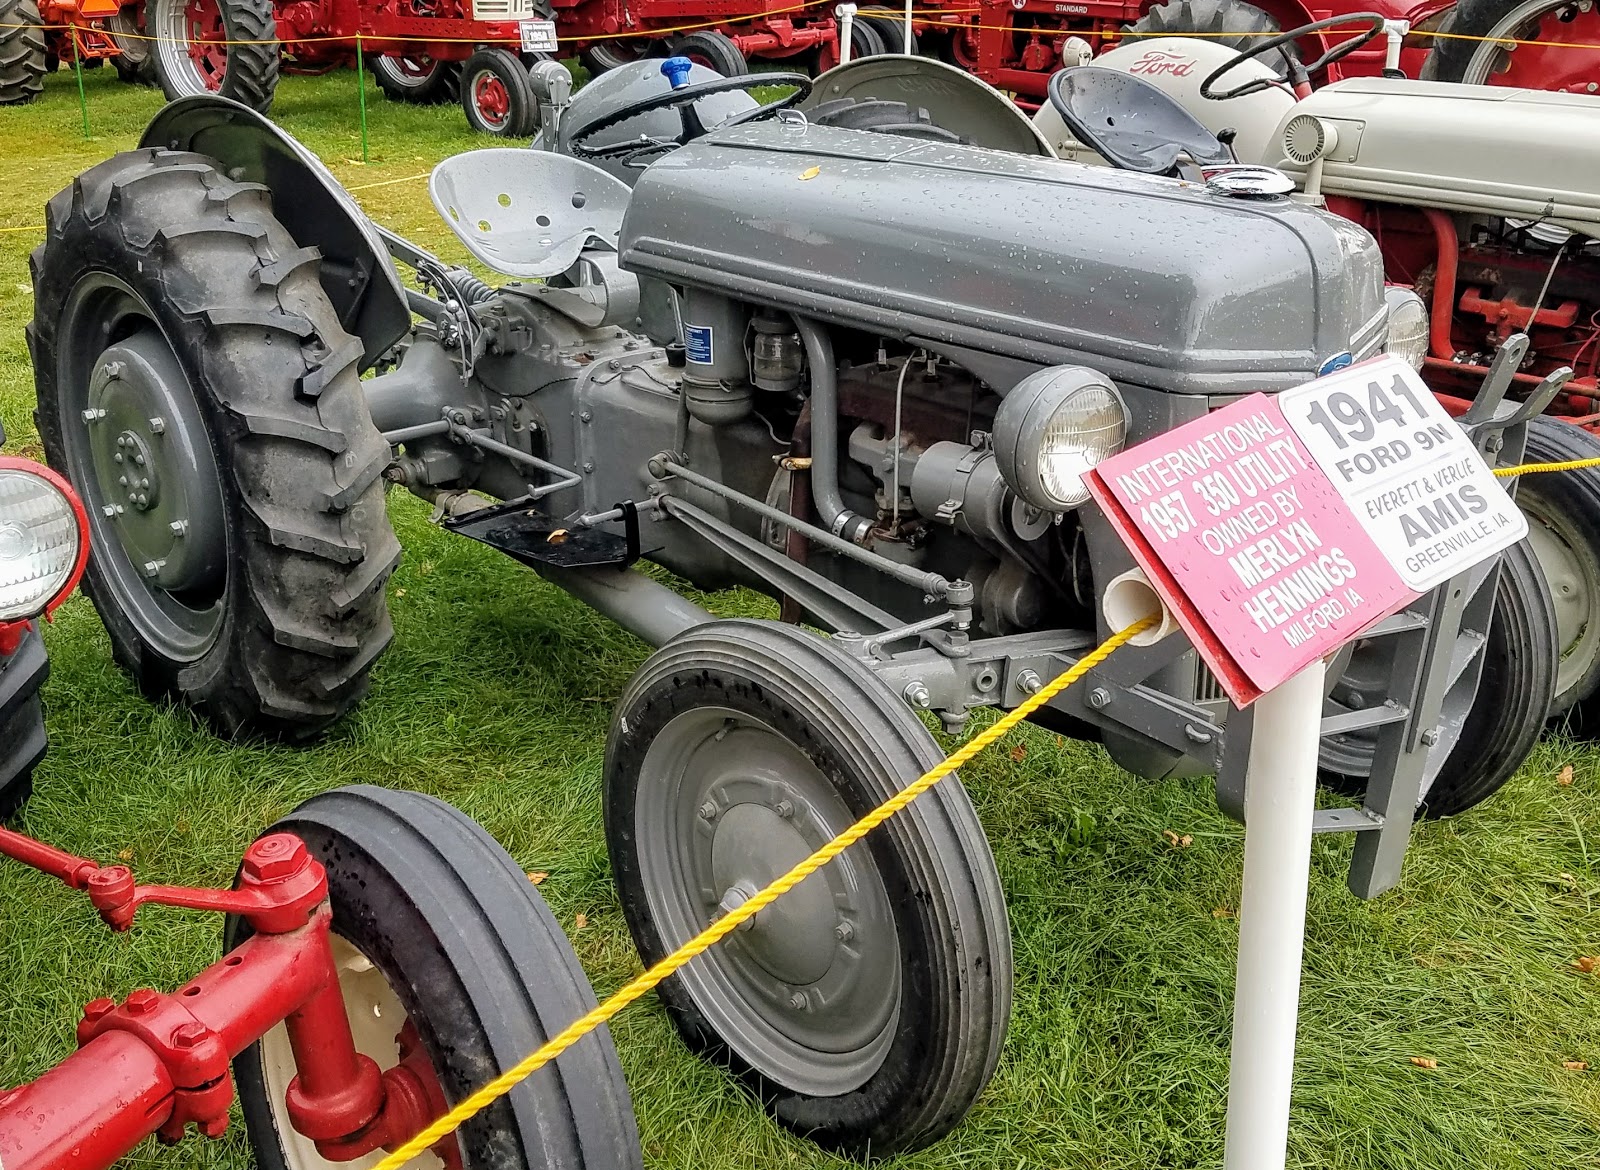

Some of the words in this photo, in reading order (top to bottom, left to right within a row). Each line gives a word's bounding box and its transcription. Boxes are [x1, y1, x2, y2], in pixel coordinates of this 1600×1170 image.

[1055, 4, 1088, 14] STANDARD
[1129, 51, 1198, 77] Ford
[1306, 373, 1430, 450] 1941
[1115, 411, 1285, 504] INTERNATIONAL
[1335, 439, 1412, 483] FORD
[1413, 423, 1454, 451] 9N
[1140, 490, 1198, 543] 1957
[1192, 470, 1241, 517] 350
[1227, 435, 1308, 498] UTILITY
[1201, 501, 1279, 556] OWNED
[1271, 484, 1304, 518] BY
[1364, 480, 1425, 520] EVERETT
[1422, 477, 1437, 493] &
[1433, 457, 1475, 487] VERLIE
[1398, 484, 1488, 548] AMIS
[1227, 517, 1323, 590] MERLYN
[1243, 547, 1358, 634] HENNINGS
[1281, 598, 1352, 649] MILFORD,
[1343, 587, 1365, 609] IA
